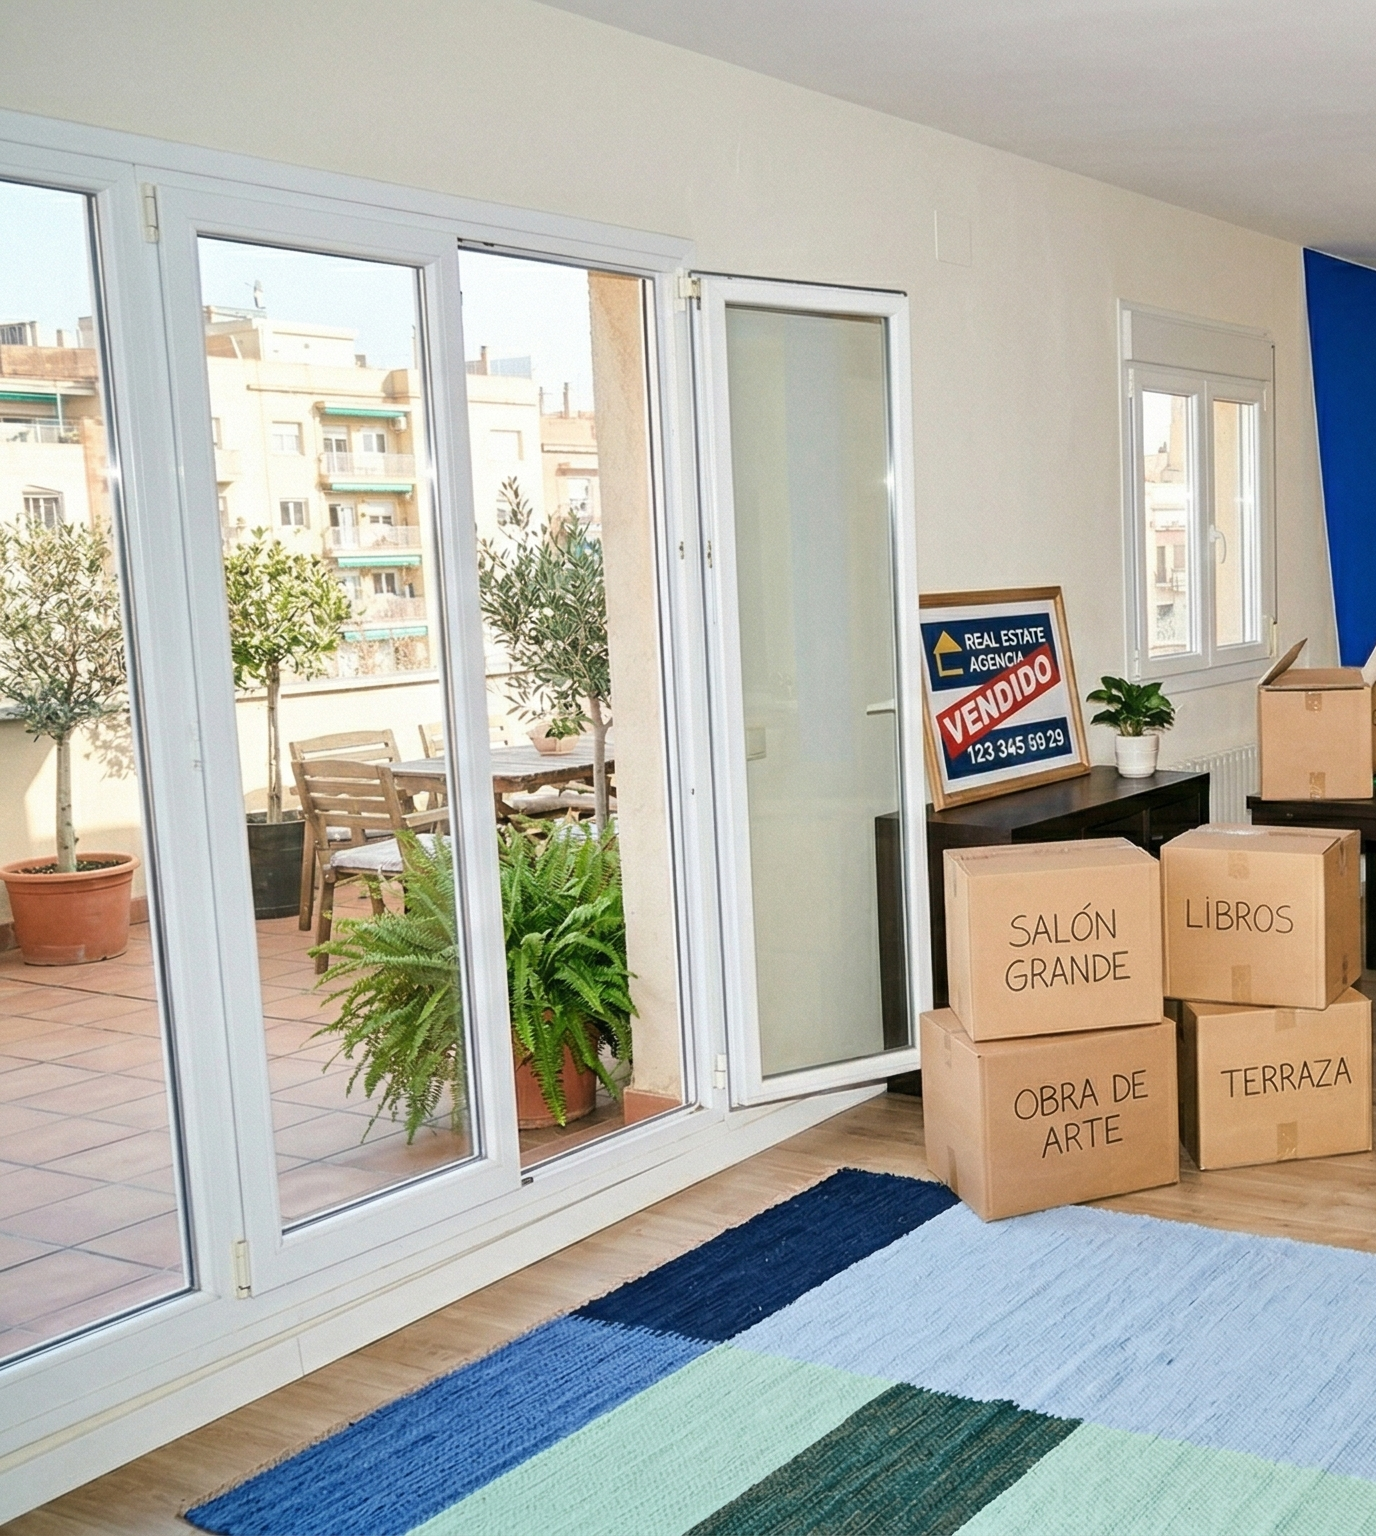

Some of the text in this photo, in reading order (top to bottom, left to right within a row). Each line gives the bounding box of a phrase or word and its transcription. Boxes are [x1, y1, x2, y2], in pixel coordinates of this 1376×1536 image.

[965, 627, 1046, 650] REAL ESTATE
[970, 651, 1024, 672] AGENCIA
[943, 654, 1052, 744] VENDIDO
[967, 742, 995, 764] 123
[997, 736, 1025, 758] 345
[1047, 728, 1064, 748] 29
[1008, 902, 1117, 948] SALÓN
[1186, 896, 1294, 934] LIBROS
[1004, 950, 1131, 992] GRANDE
[1013, 1069, 1149, 1120] OBRA DE
[1220, 1056, 1352, 1098] TERRAZA
[1041, 1114, 1123, 1159] ARTE
